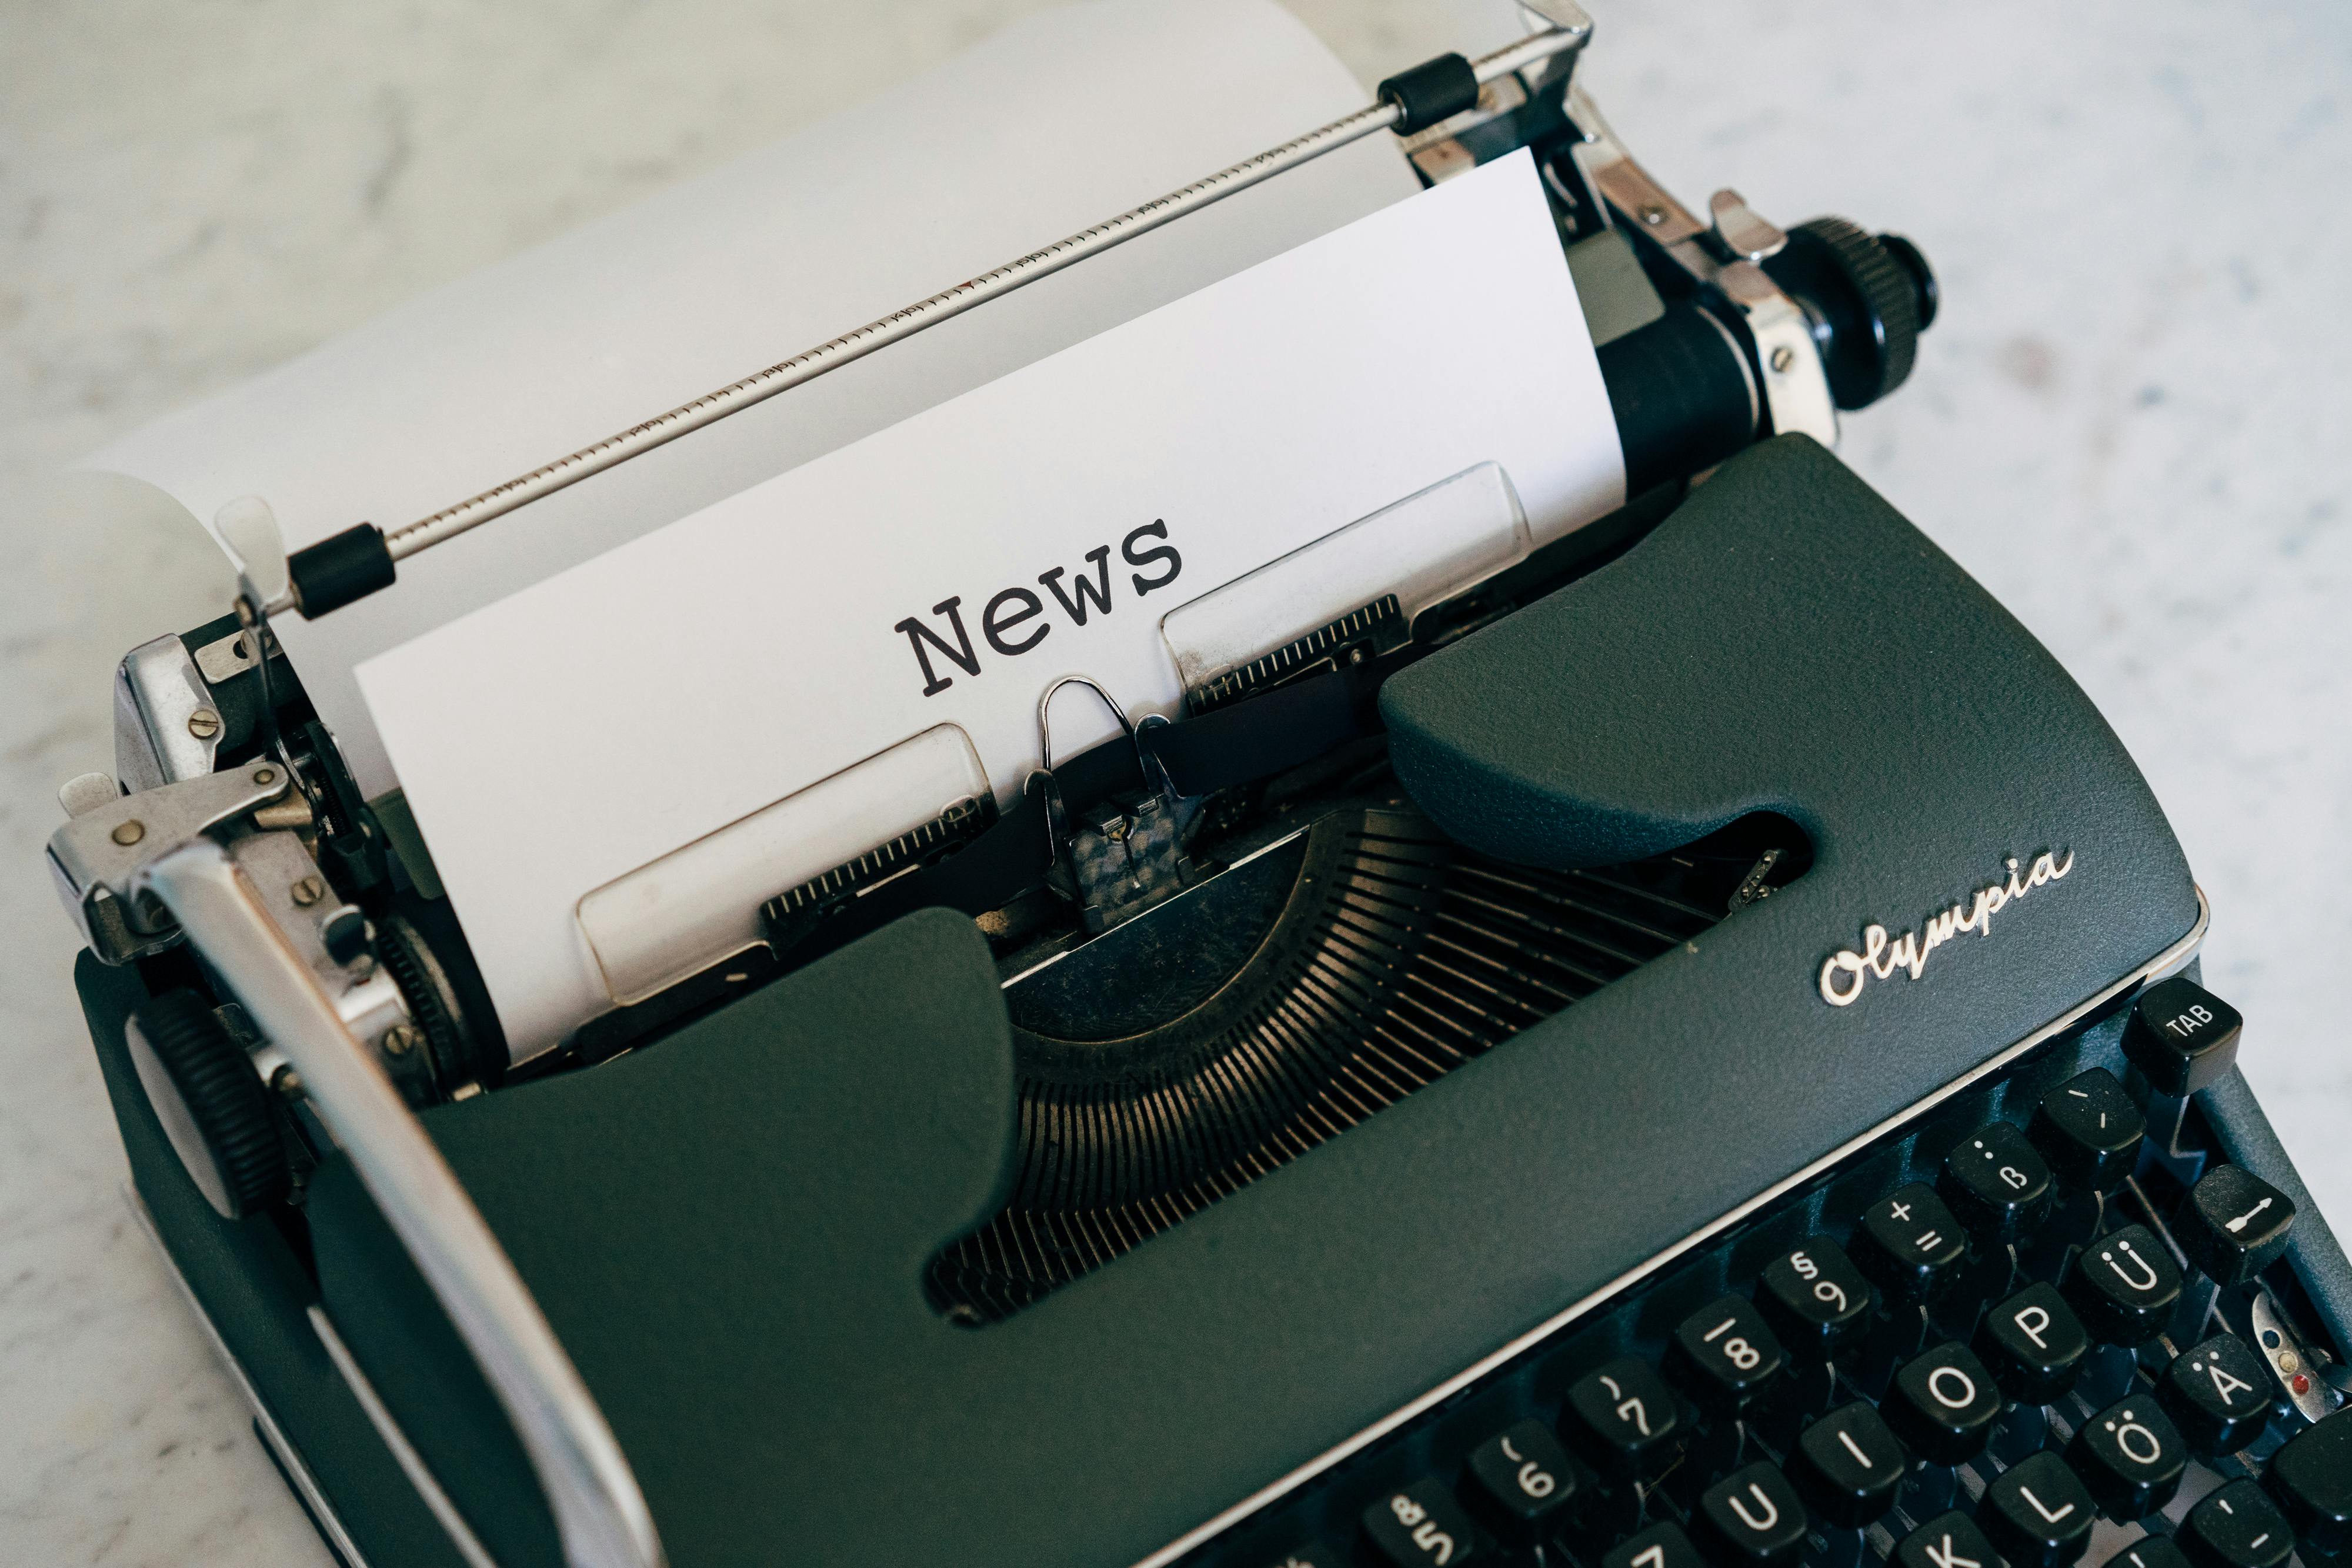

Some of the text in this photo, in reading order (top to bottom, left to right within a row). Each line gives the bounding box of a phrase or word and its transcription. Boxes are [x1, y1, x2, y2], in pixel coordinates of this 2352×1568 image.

[763, 363, 788, 375] 30
[894, 307, 916, 318] 40
[1016, 253, 1042, 264] 50
[1138, 201, 1162, 211] 60
[894, 518, 1182, 698] News
[1820, 850, 2075, 1006] Olympia
[2166, 1005, 2213, 1036] TAB
[2101, 1240, 2157, 1290] Ü
[1814, 1282, 1846, 1312] 9
[2014, 1306, 2050, 1349] P
[1724, 1338, 1760, 1370] 8
[1929, 1366, 1976, 1408] O
[2192, 1351, 2253, 1405] Ä
[1617, 1397, 1650, 1436] 7
[2105, 1410, 2160, 1464] Ö
[1518, 1462, 1555, 1498] 6
[1729, 1484, 1777, 1530] U
[2020, 1486, 2074, 1523] L
[1412, 1520, 1454, 1566] 5
[1926, 1534, 1981, 1568] K
